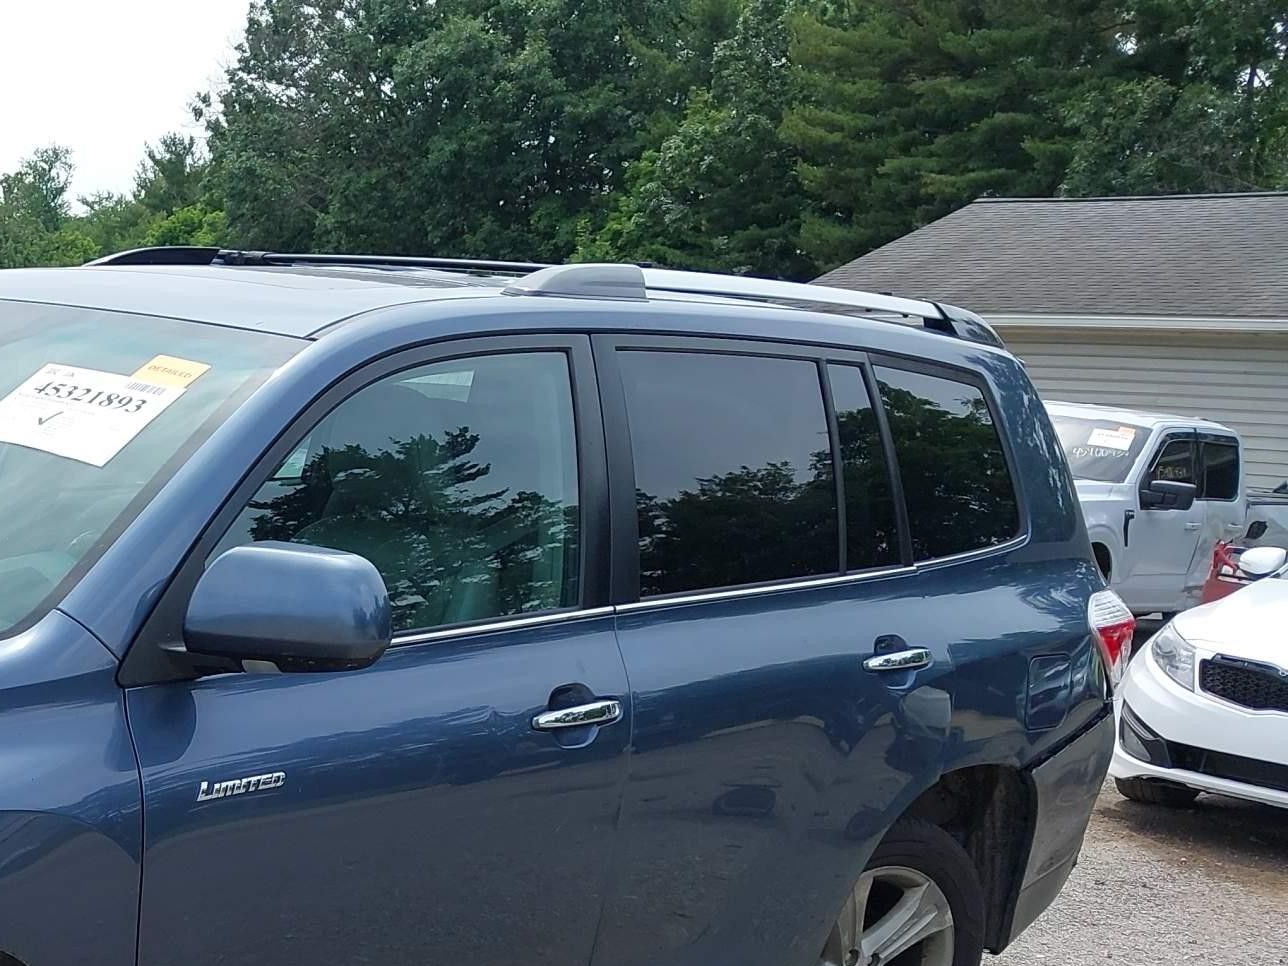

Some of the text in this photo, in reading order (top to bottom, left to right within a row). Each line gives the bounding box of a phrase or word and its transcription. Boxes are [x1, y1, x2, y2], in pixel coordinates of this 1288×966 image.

[147, 364, 193, 380] DETAILED
[34, 381, 148, 414] 45321893
[196, 771, 287, 802] LIMITED
